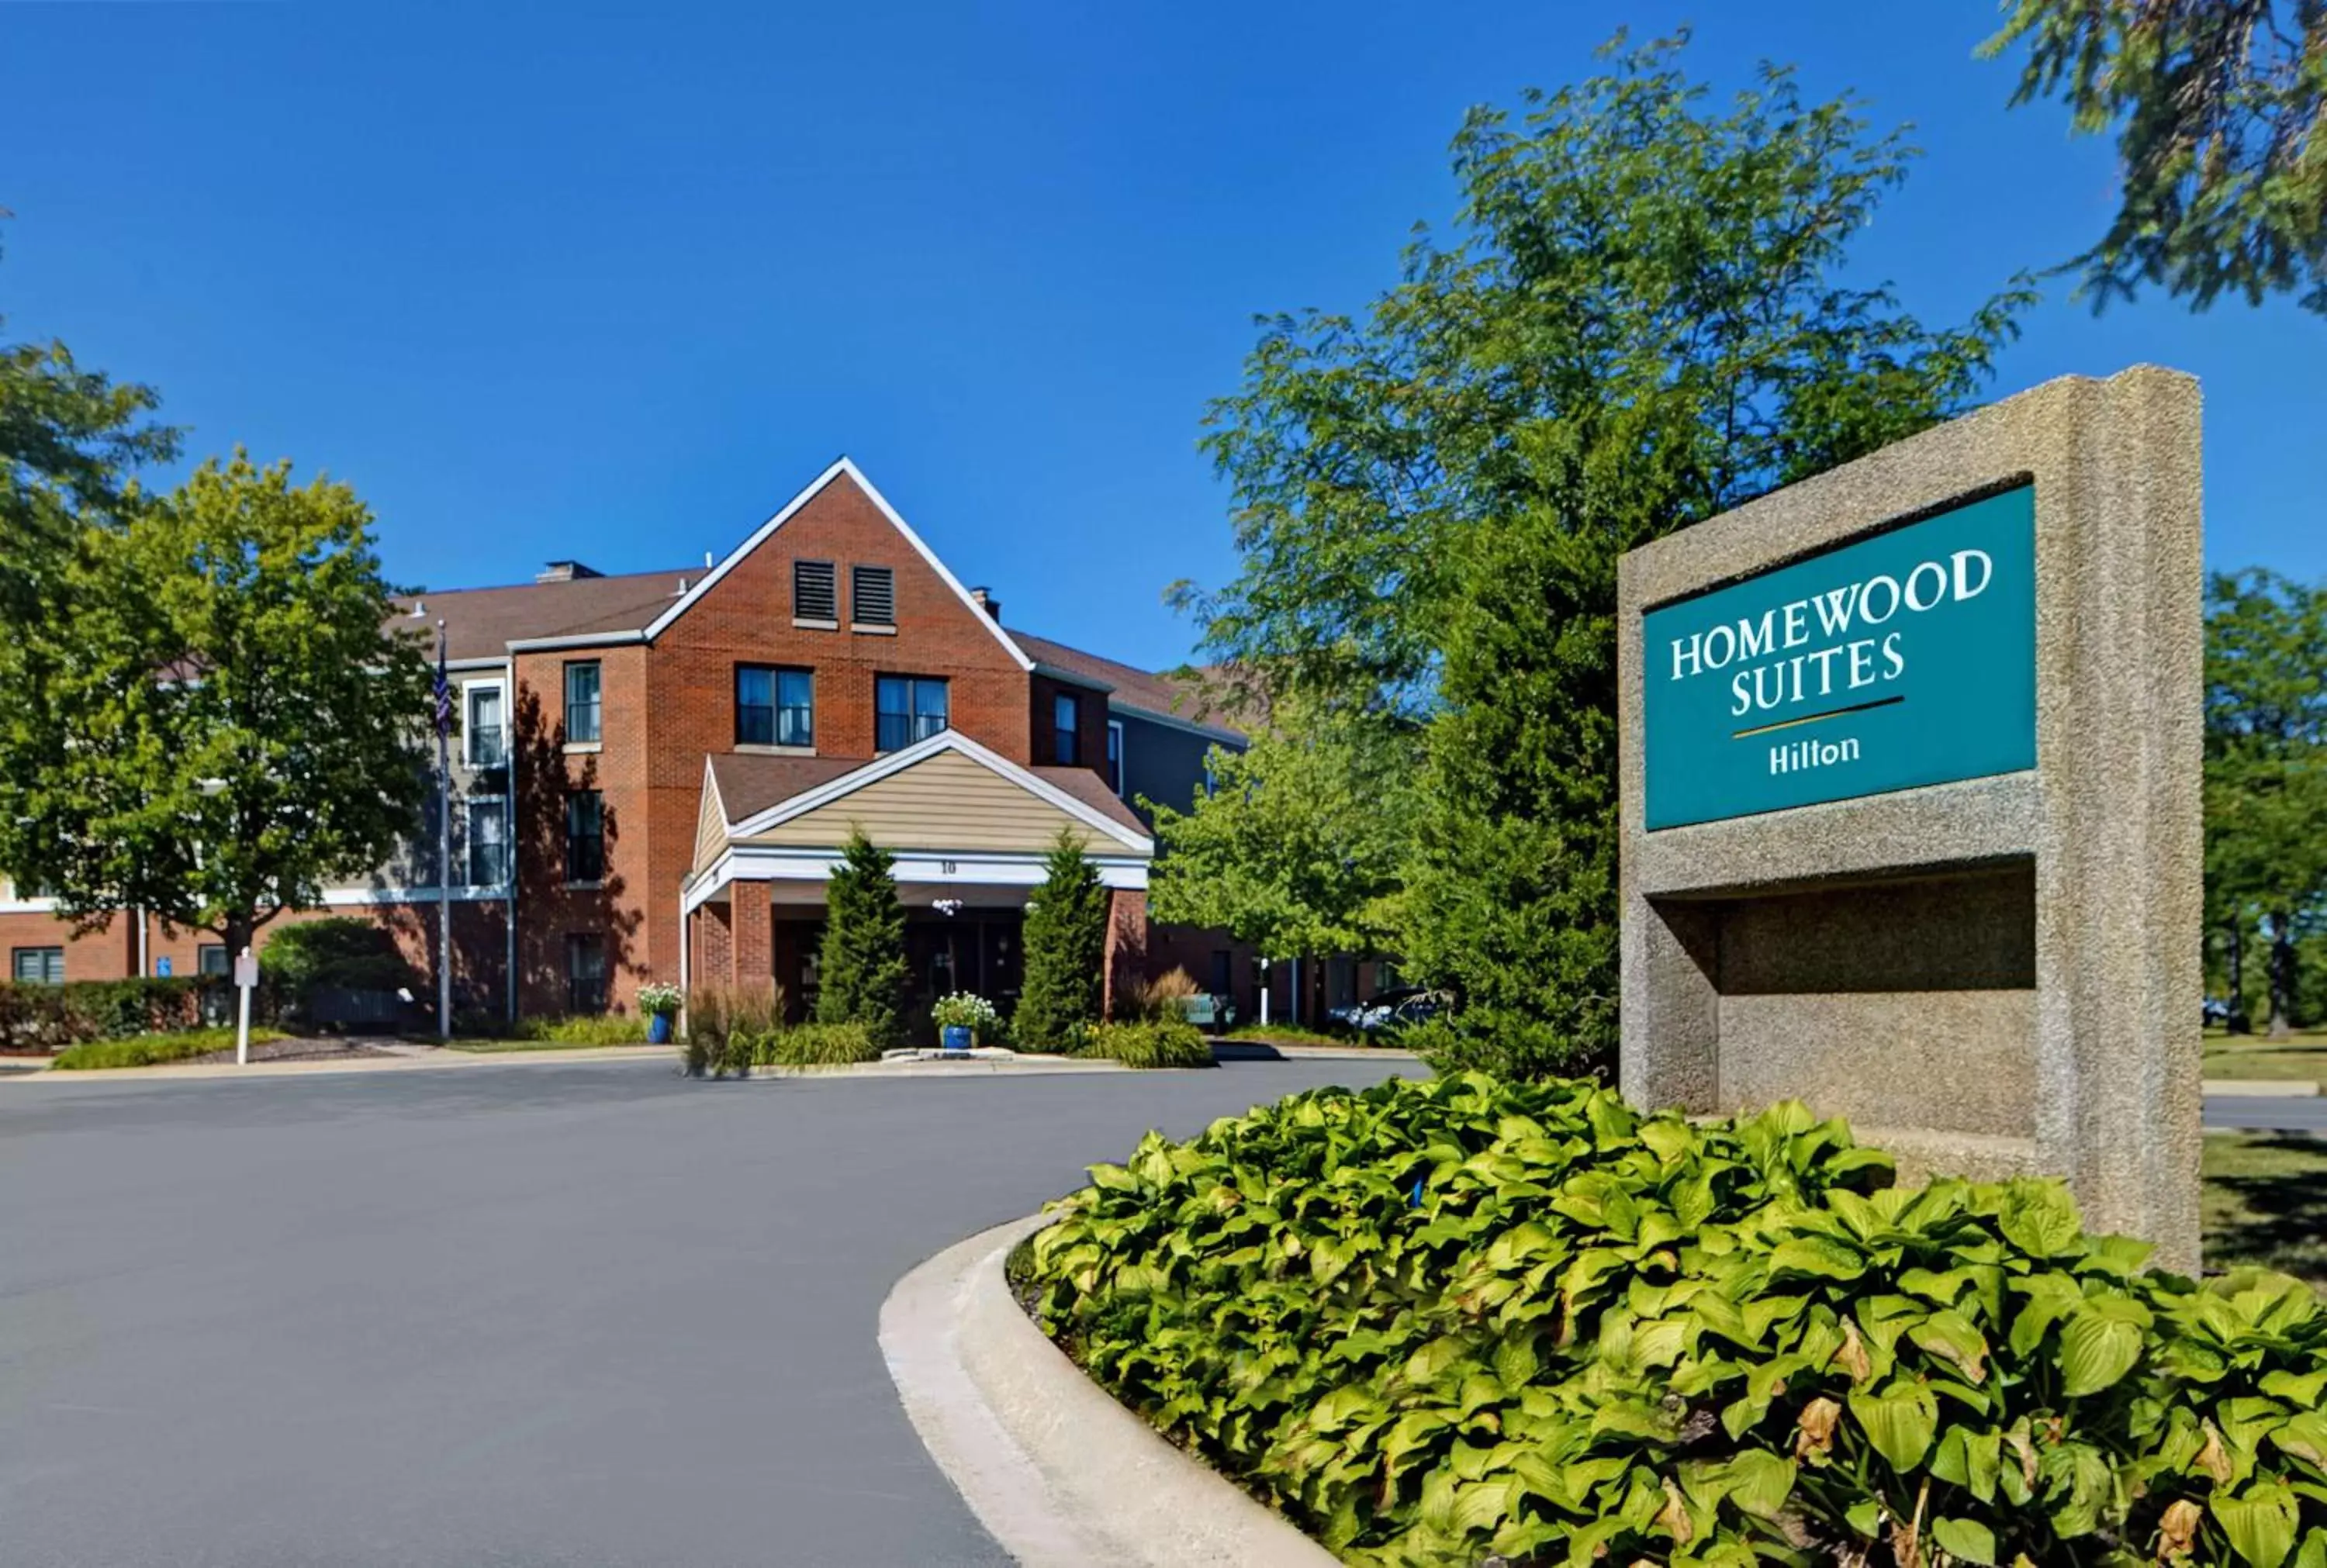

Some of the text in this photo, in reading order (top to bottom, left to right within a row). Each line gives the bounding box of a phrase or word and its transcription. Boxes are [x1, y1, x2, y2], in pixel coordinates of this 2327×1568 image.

[1670, 549, 1993, 681] HOMEWOOD
[1731, 632, 1904, 717] SUITES
[1769, 737, 1860, 775] Hilton
